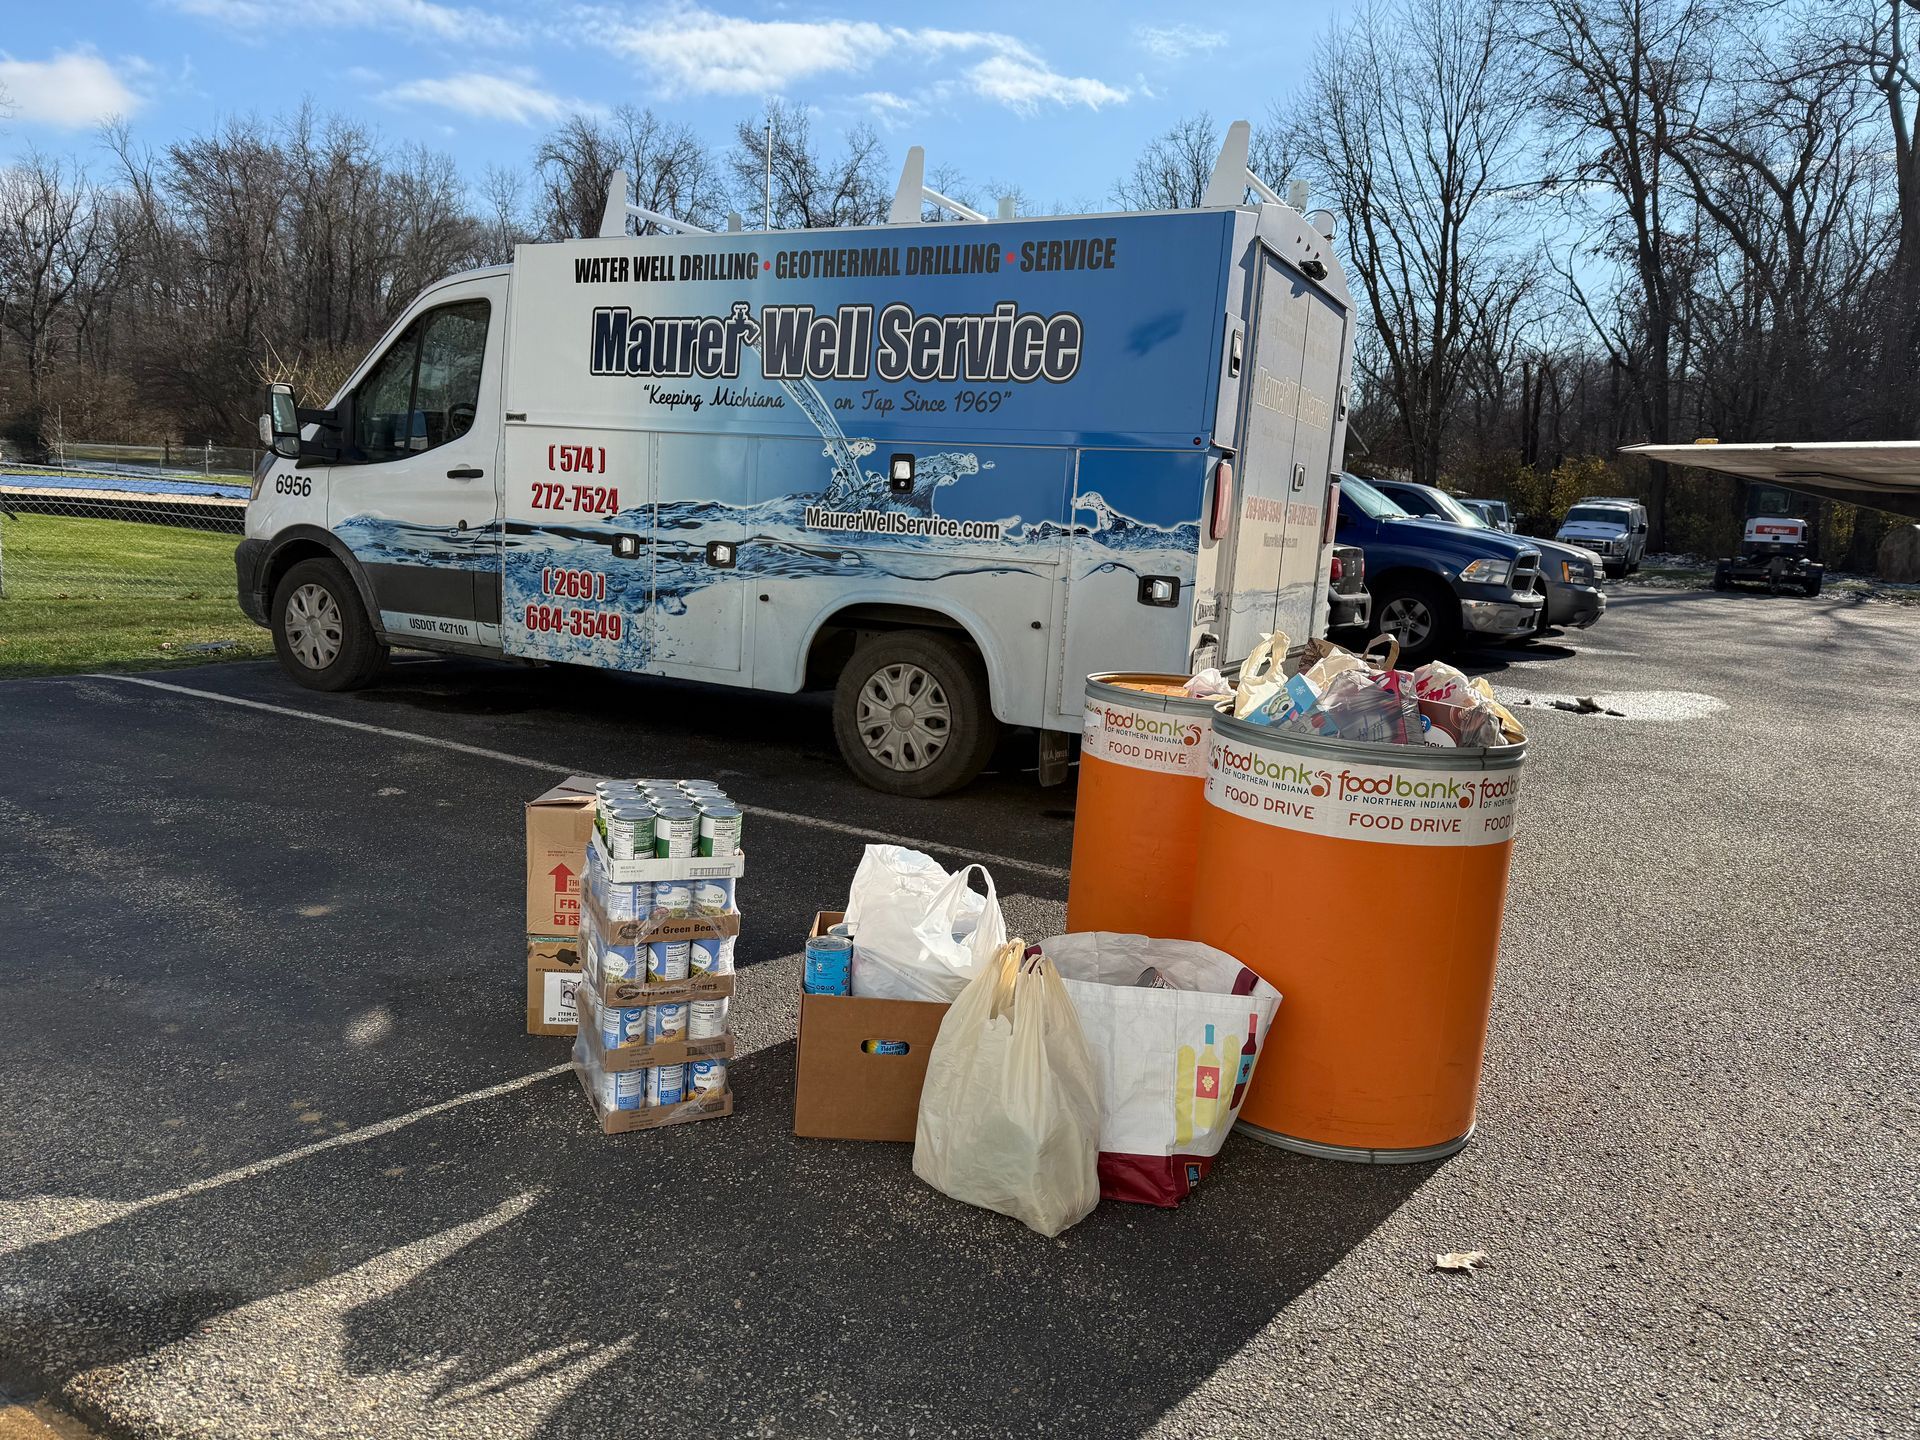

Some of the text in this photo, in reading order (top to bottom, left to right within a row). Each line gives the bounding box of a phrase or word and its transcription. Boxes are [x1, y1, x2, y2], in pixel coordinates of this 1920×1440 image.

[575, 238, 1117, 283] WATER WELL DRILLING GEOTHERMAL DRILLING SERVICE
[590, 301, 1085, 384] Maurer Well Service
[709, 385, 785, 409] Michiana
[834, 397, 854, 410] on
[862, 389, 895, 418] Tap
[900, 390, 947, 412] Since
[276, 474, 312, 498] 6956
[531, 482, 619, 515] 272-7524
[806, 507, 1000, 540] MaurerWellService.com
[409, 618, 469, 636] USDOT 427101
[526, 604, 621, 641] 684-3549
[1116, 728, 1149, 740] NORTHERN
[1151, 735, 1182, 745] INDIANA
[1108, 741, 1187, 764] FOOD DRIVE
[1233, 771, 1269, 787] NORTHERN
[1272, 782, 1310, 796] INDIANA
[1225, 785, 1315, 820] FOOD DRIVE
[1345, 794, 1458, 809] OF NORTHERN INDIANA
[1349, 812, 1462, 832] FOOD DRIVE
[1484, 815, 1510, 831] FOOD
[651, 927, 659, 935] ut
[663, 925, 690, 935] Green
